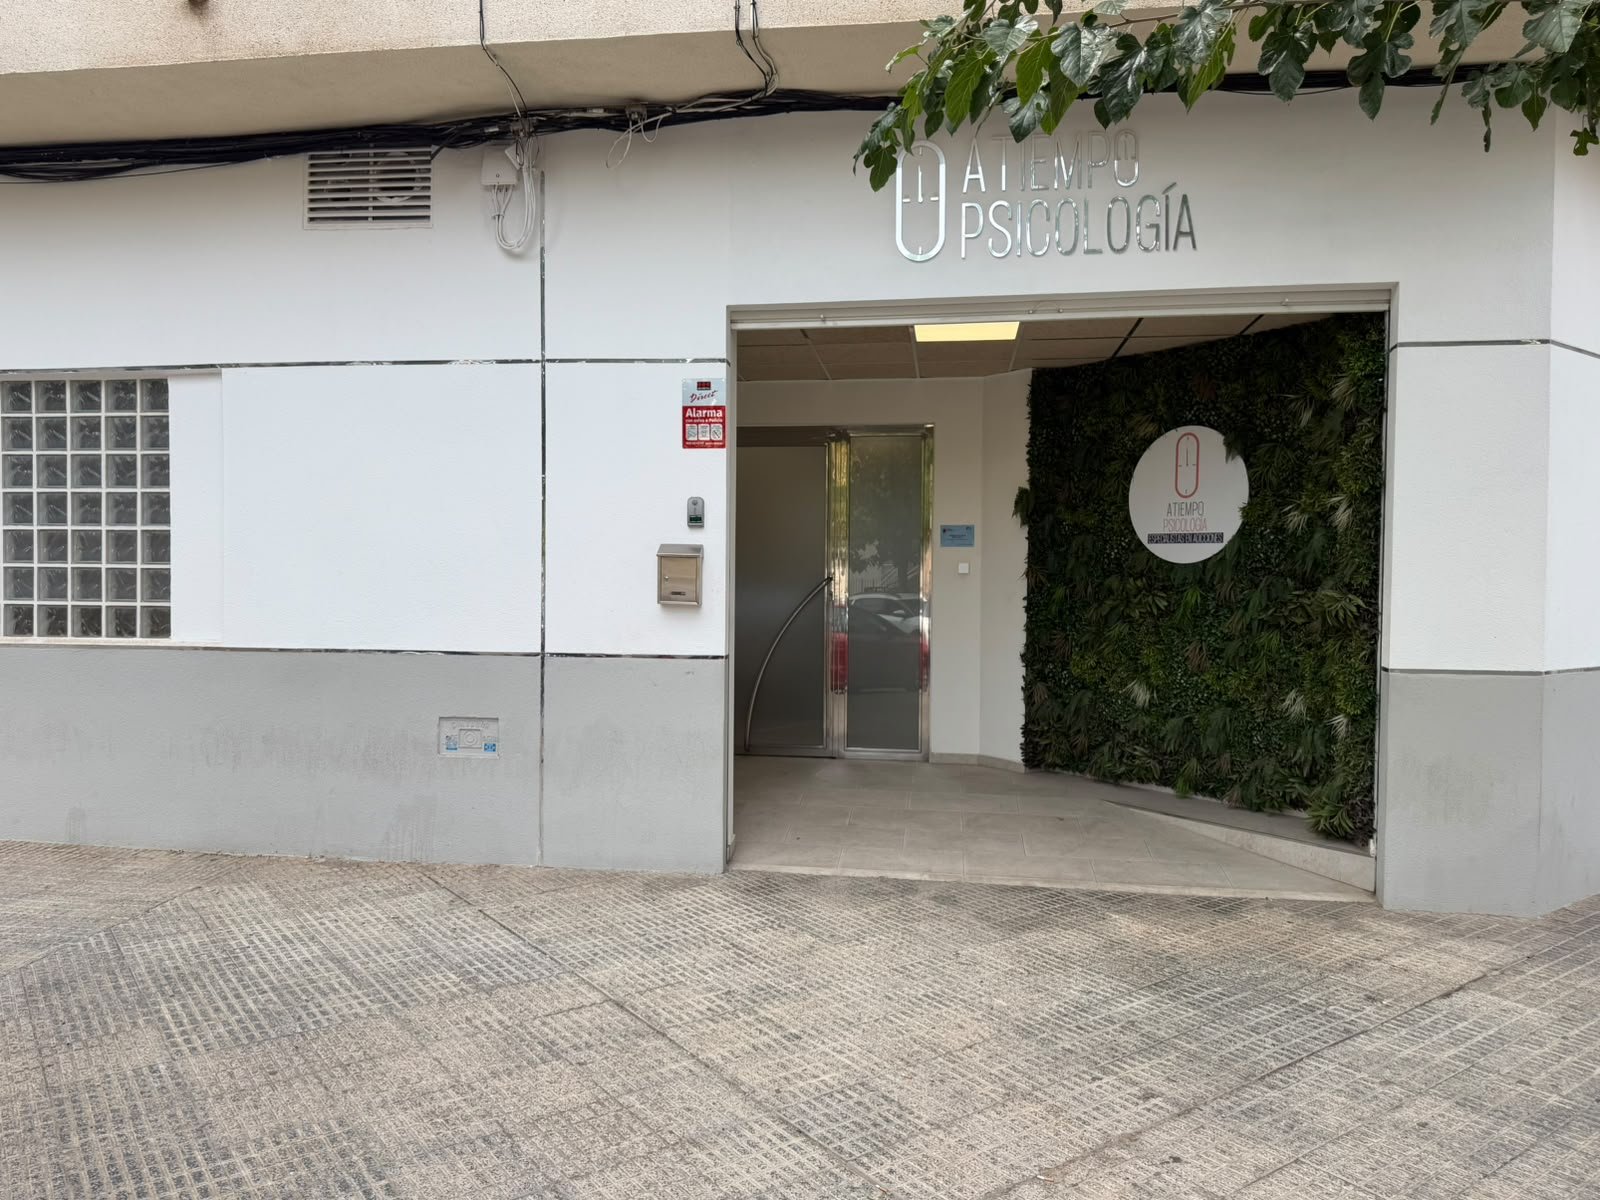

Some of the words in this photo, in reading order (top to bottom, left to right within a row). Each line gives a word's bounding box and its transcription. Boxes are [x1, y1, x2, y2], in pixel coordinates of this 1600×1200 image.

[961, 182, 1198, 260] PSICOLOGÍA
[685, 408, 723, 417] Alarma
[1166, 501, 1205, 517] ATIEMPO
